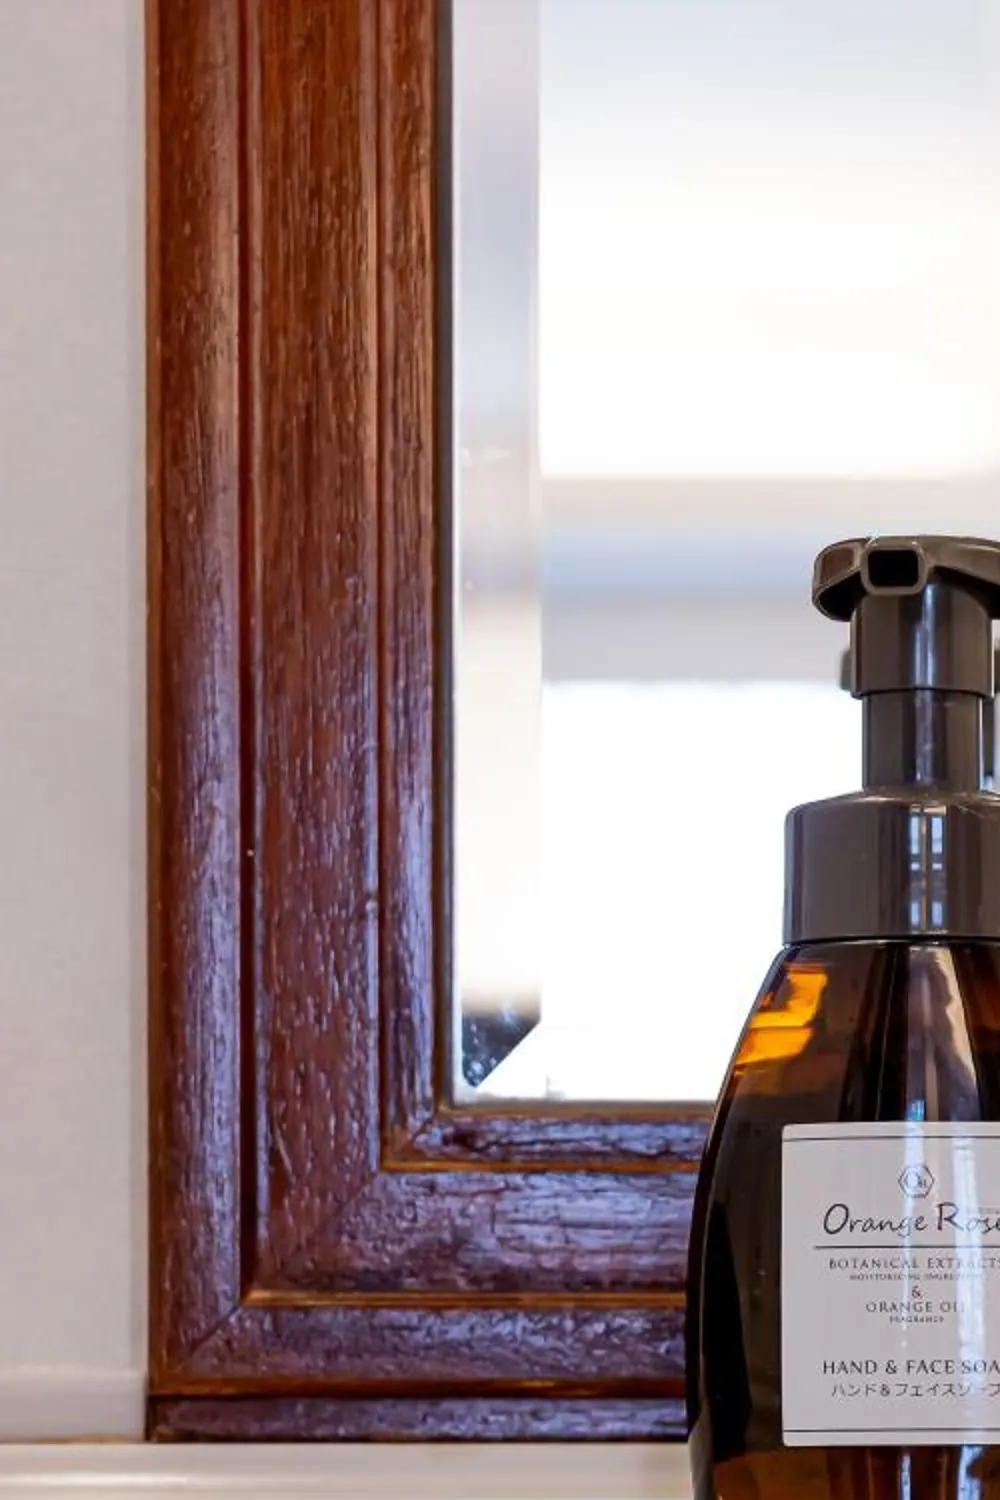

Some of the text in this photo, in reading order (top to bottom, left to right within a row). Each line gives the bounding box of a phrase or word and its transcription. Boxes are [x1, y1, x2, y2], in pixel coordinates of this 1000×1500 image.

[823, 1202, 928, 1238] Orange
[828, 1257, 920, 1270] BOTANICAL
[911, 1285, 921, 1298] &
[865, 1301, 933, 1313] ORANGE
[822, 1359, 878, 1375] HAND
[885, 1359, 898, 1375] &
[906, 1359, 955, 1375] FACE
